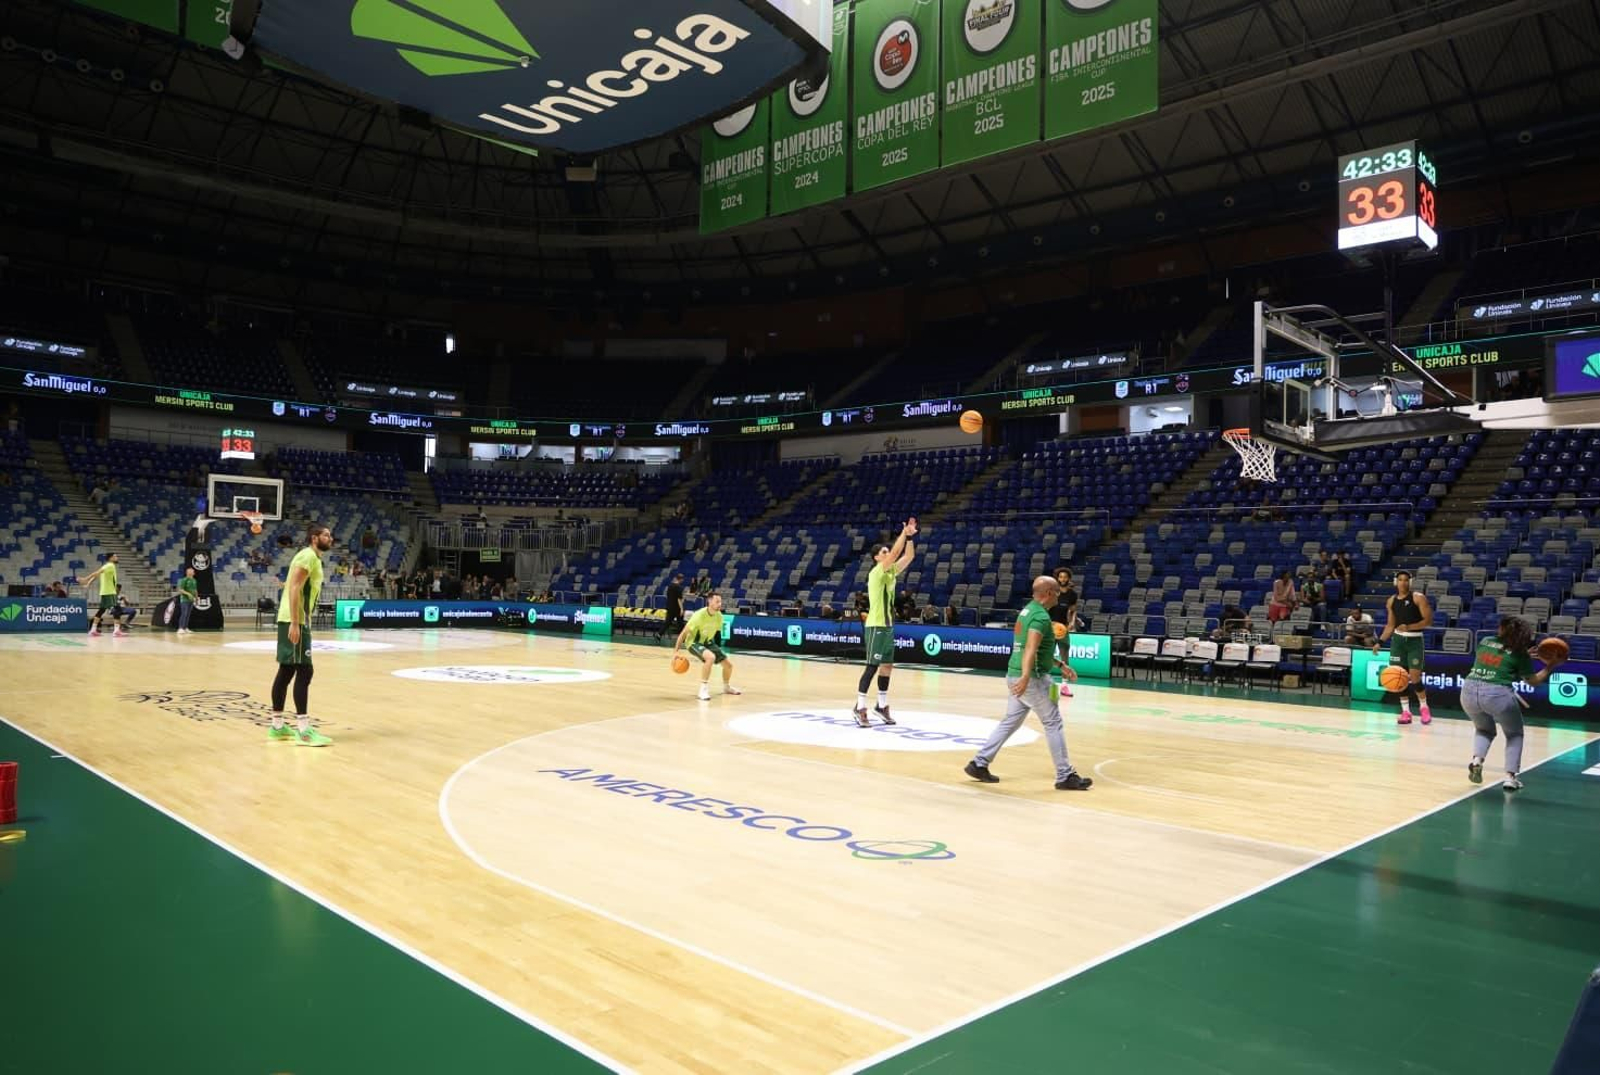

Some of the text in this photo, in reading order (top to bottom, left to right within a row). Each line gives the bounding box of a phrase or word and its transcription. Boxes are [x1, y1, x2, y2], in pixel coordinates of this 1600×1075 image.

[1049, 17, 1152, 75] CAMPEONES
[478, 13, 751, 134] Unicaja
[946, 54, 1036, 105] CAMPEONES
[1081, 81, 1115, 105] 2025
[857, 92, 935, 138] CAMPEONES
[976, 98, 1002, 115] BCL
[974, 113, 1004, 134] 2025
[773, 120, 843, 162] CAMPEONES
[857, 116, 935, 150] COPA DEL REY
[704, 146, 764, 184] CAMPEONES
[774, 143, 844, 175] SUPERCOPA
[882, 148, 908, 166] 2025
[1343, 149, 1412, 179] 42:33
[795, 171, 819, 189] 2024
[721, 194, 742, 210] 2024
[1348, 181, 1404, 225] 33
[1420, 182, 1435, 228] 33
[1416, 344, 1461, 358] UNICAJA
[1425, 355, 1467, 368] SPORTS
[1470, 351, 1499, 364] CLUB
[93, 386, 106, 394] 0,0
[1022, 389, 1052, 399] UNICAJA
[155, 395, 234, 411] MERSIN SPORTS CLUB
[1002, 395, 1075, 410] MERSIN SPORTS CLUB
[234, 439, 252, 452] 33
[26, 604, 82, 613] Fundación
[26, 614, 67, 624] Unicaja
[942, 641, 1011, 654] unicajabaloncesto
[1421, 672, 1453, 689] icaja
[536, 768, 852, 841] AMERESCO
